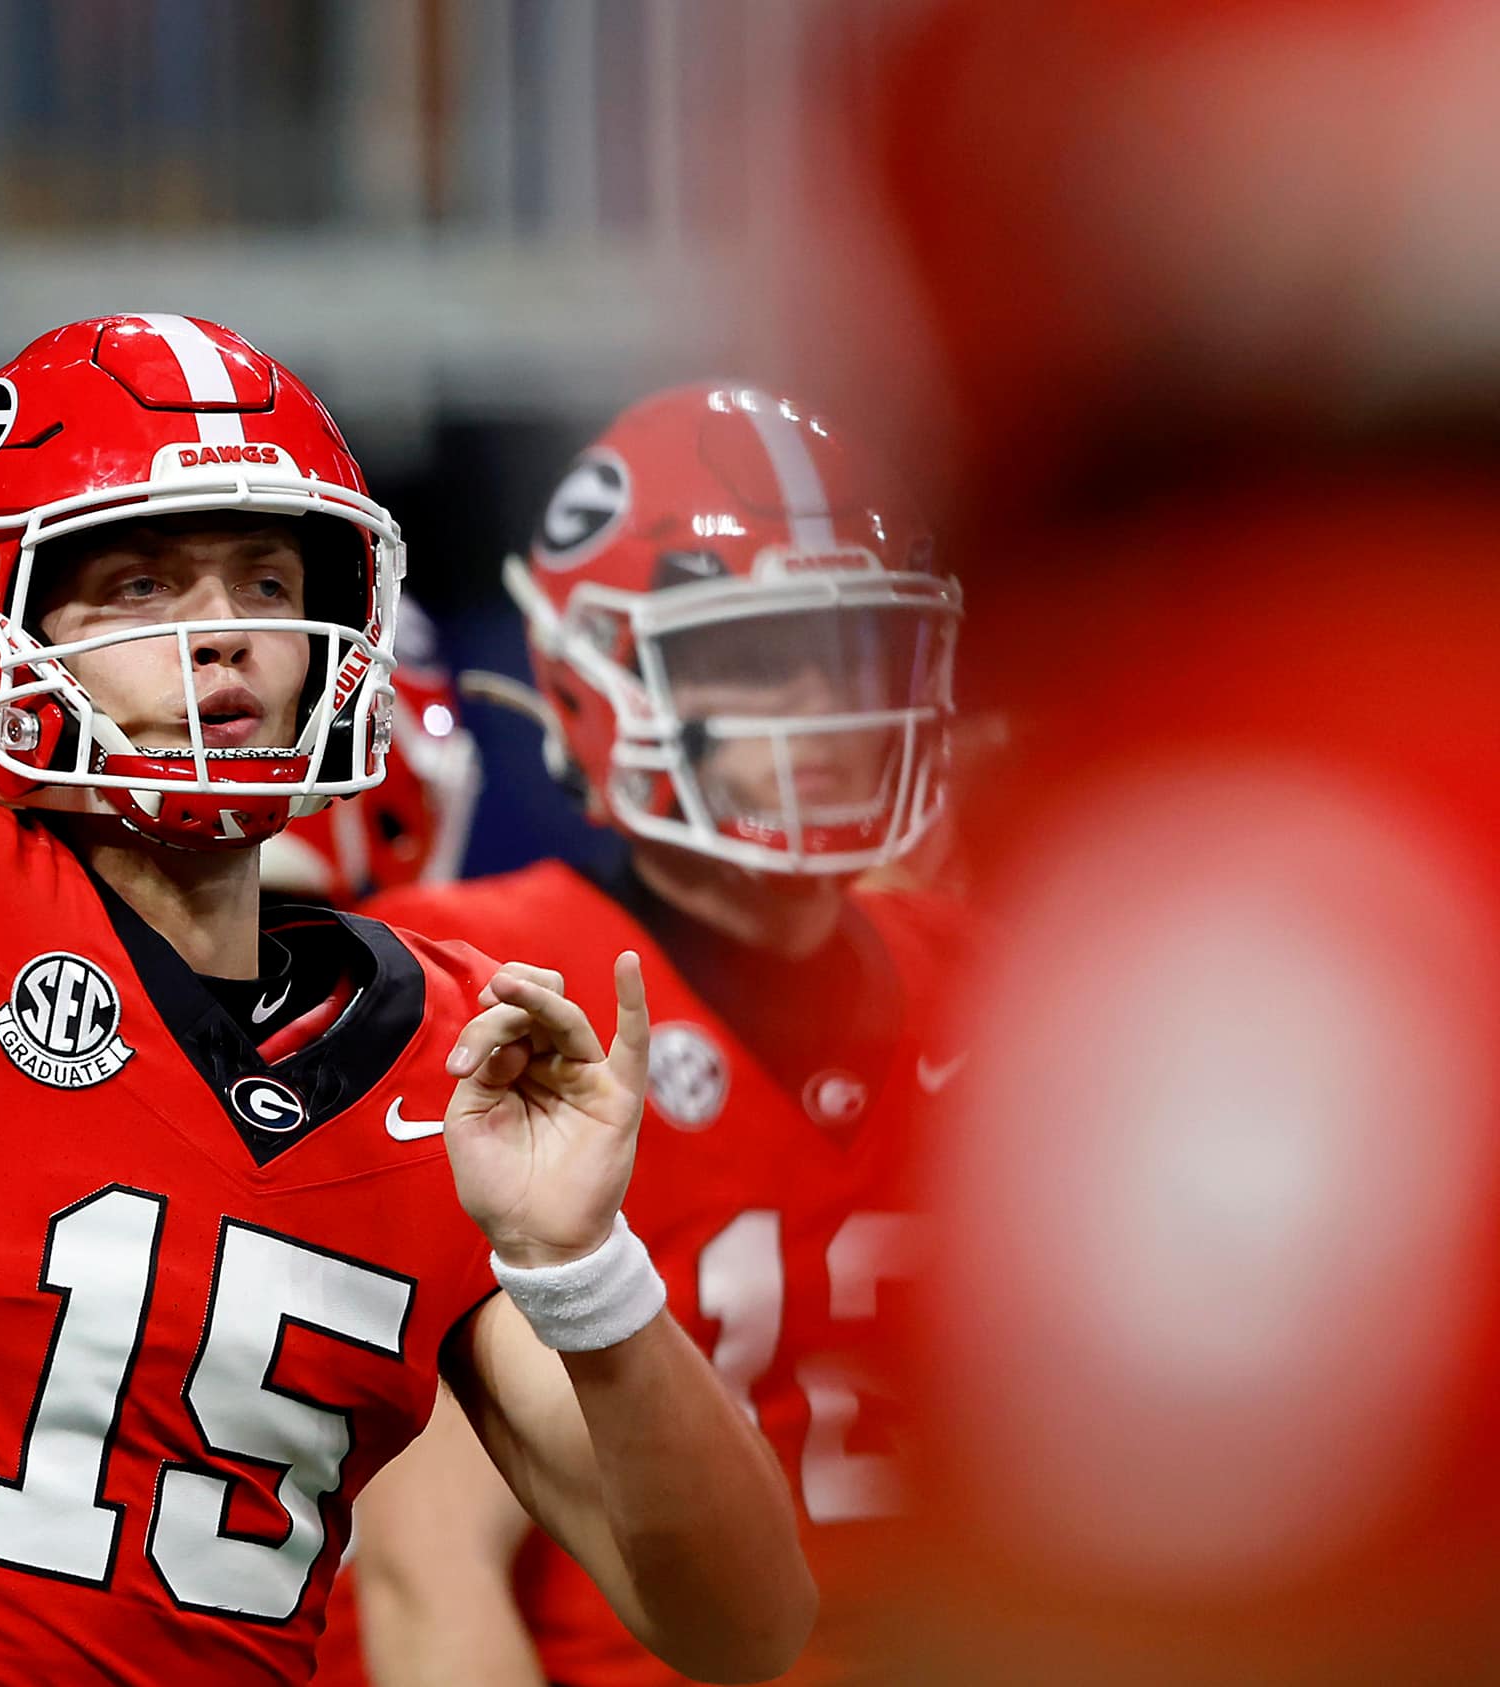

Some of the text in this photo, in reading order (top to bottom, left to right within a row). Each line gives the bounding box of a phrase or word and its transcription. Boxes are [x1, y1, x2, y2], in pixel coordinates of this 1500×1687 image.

[179, 446, 279, 467] DAWGS
[21, 960, 111, 1053] SEC
[2, 1030, 111, 1085] GRADUATE
